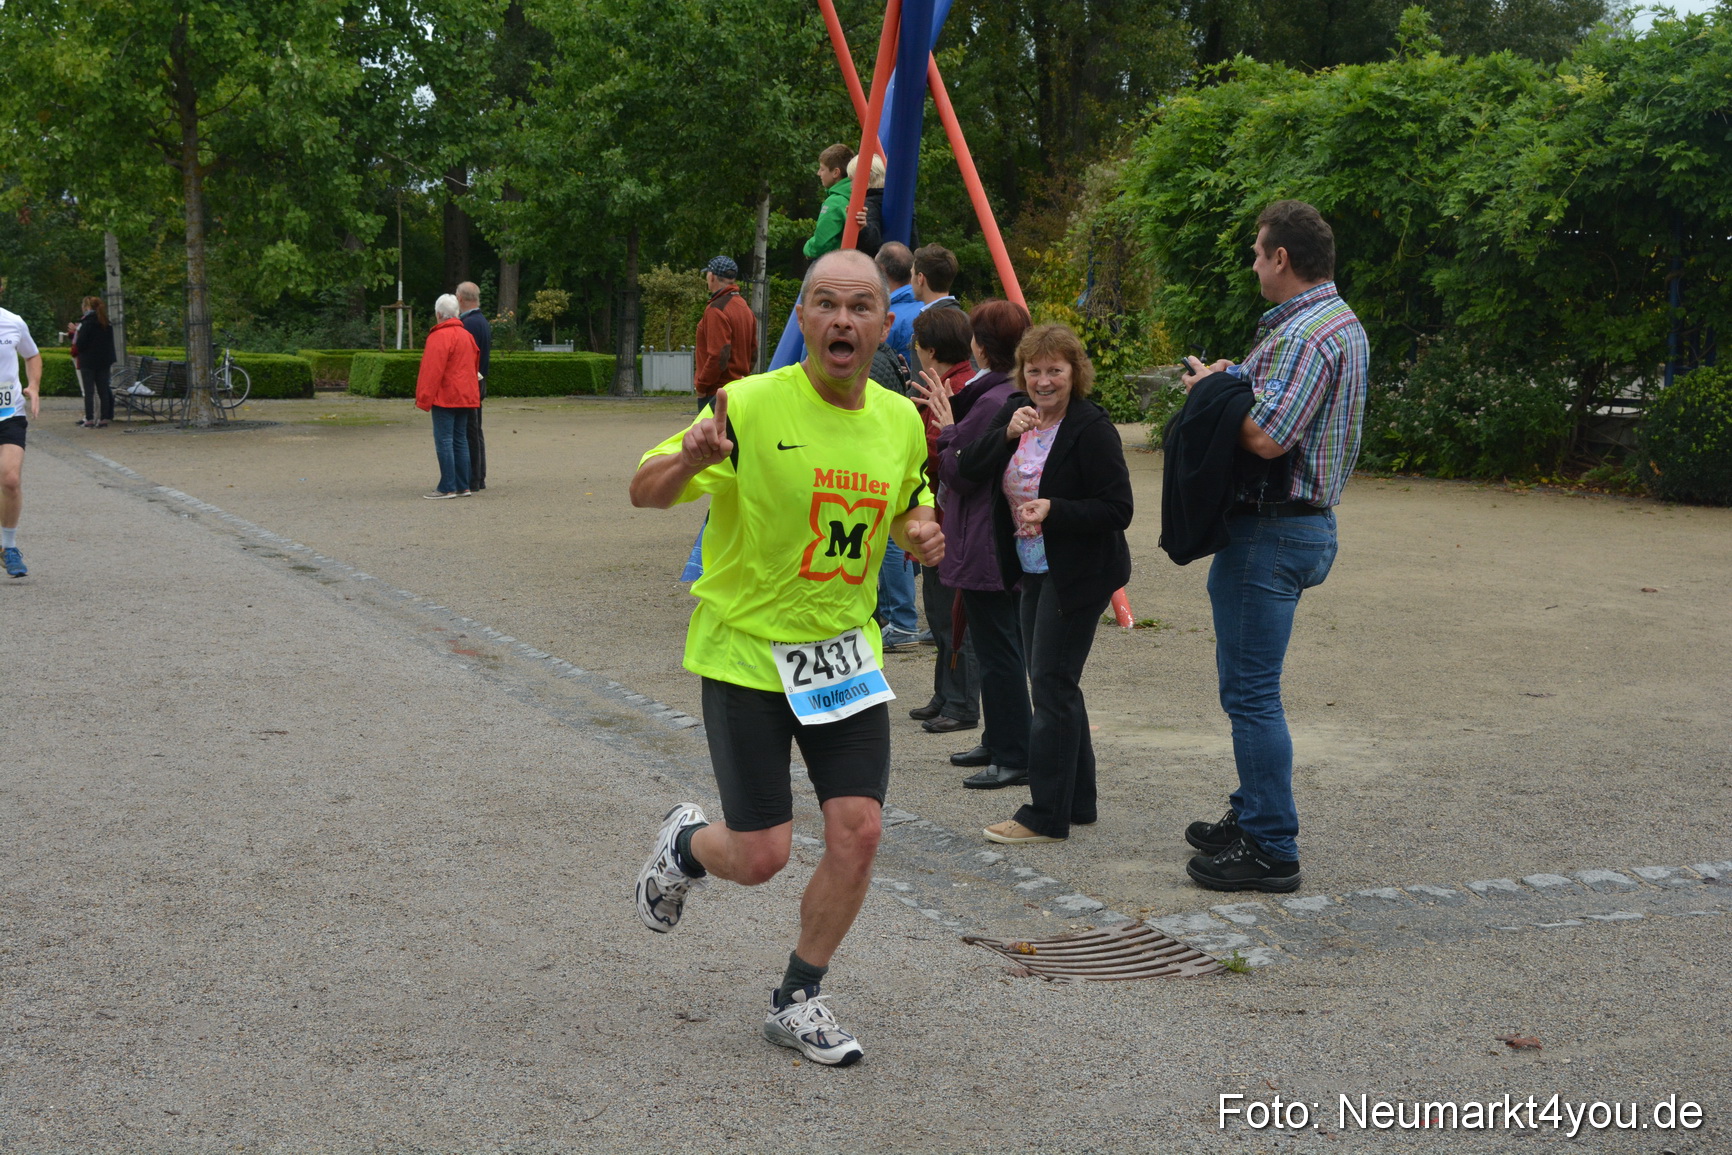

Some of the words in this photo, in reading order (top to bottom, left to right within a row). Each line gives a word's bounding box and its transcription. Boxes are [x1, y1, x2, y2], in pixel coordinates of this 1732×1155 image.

[813, 468, 890, 496] Müller
[825, 520, 868, 559] M
[786, 634, 863, 687] 2437
[807, 682, 870, 710] Wolfgang
